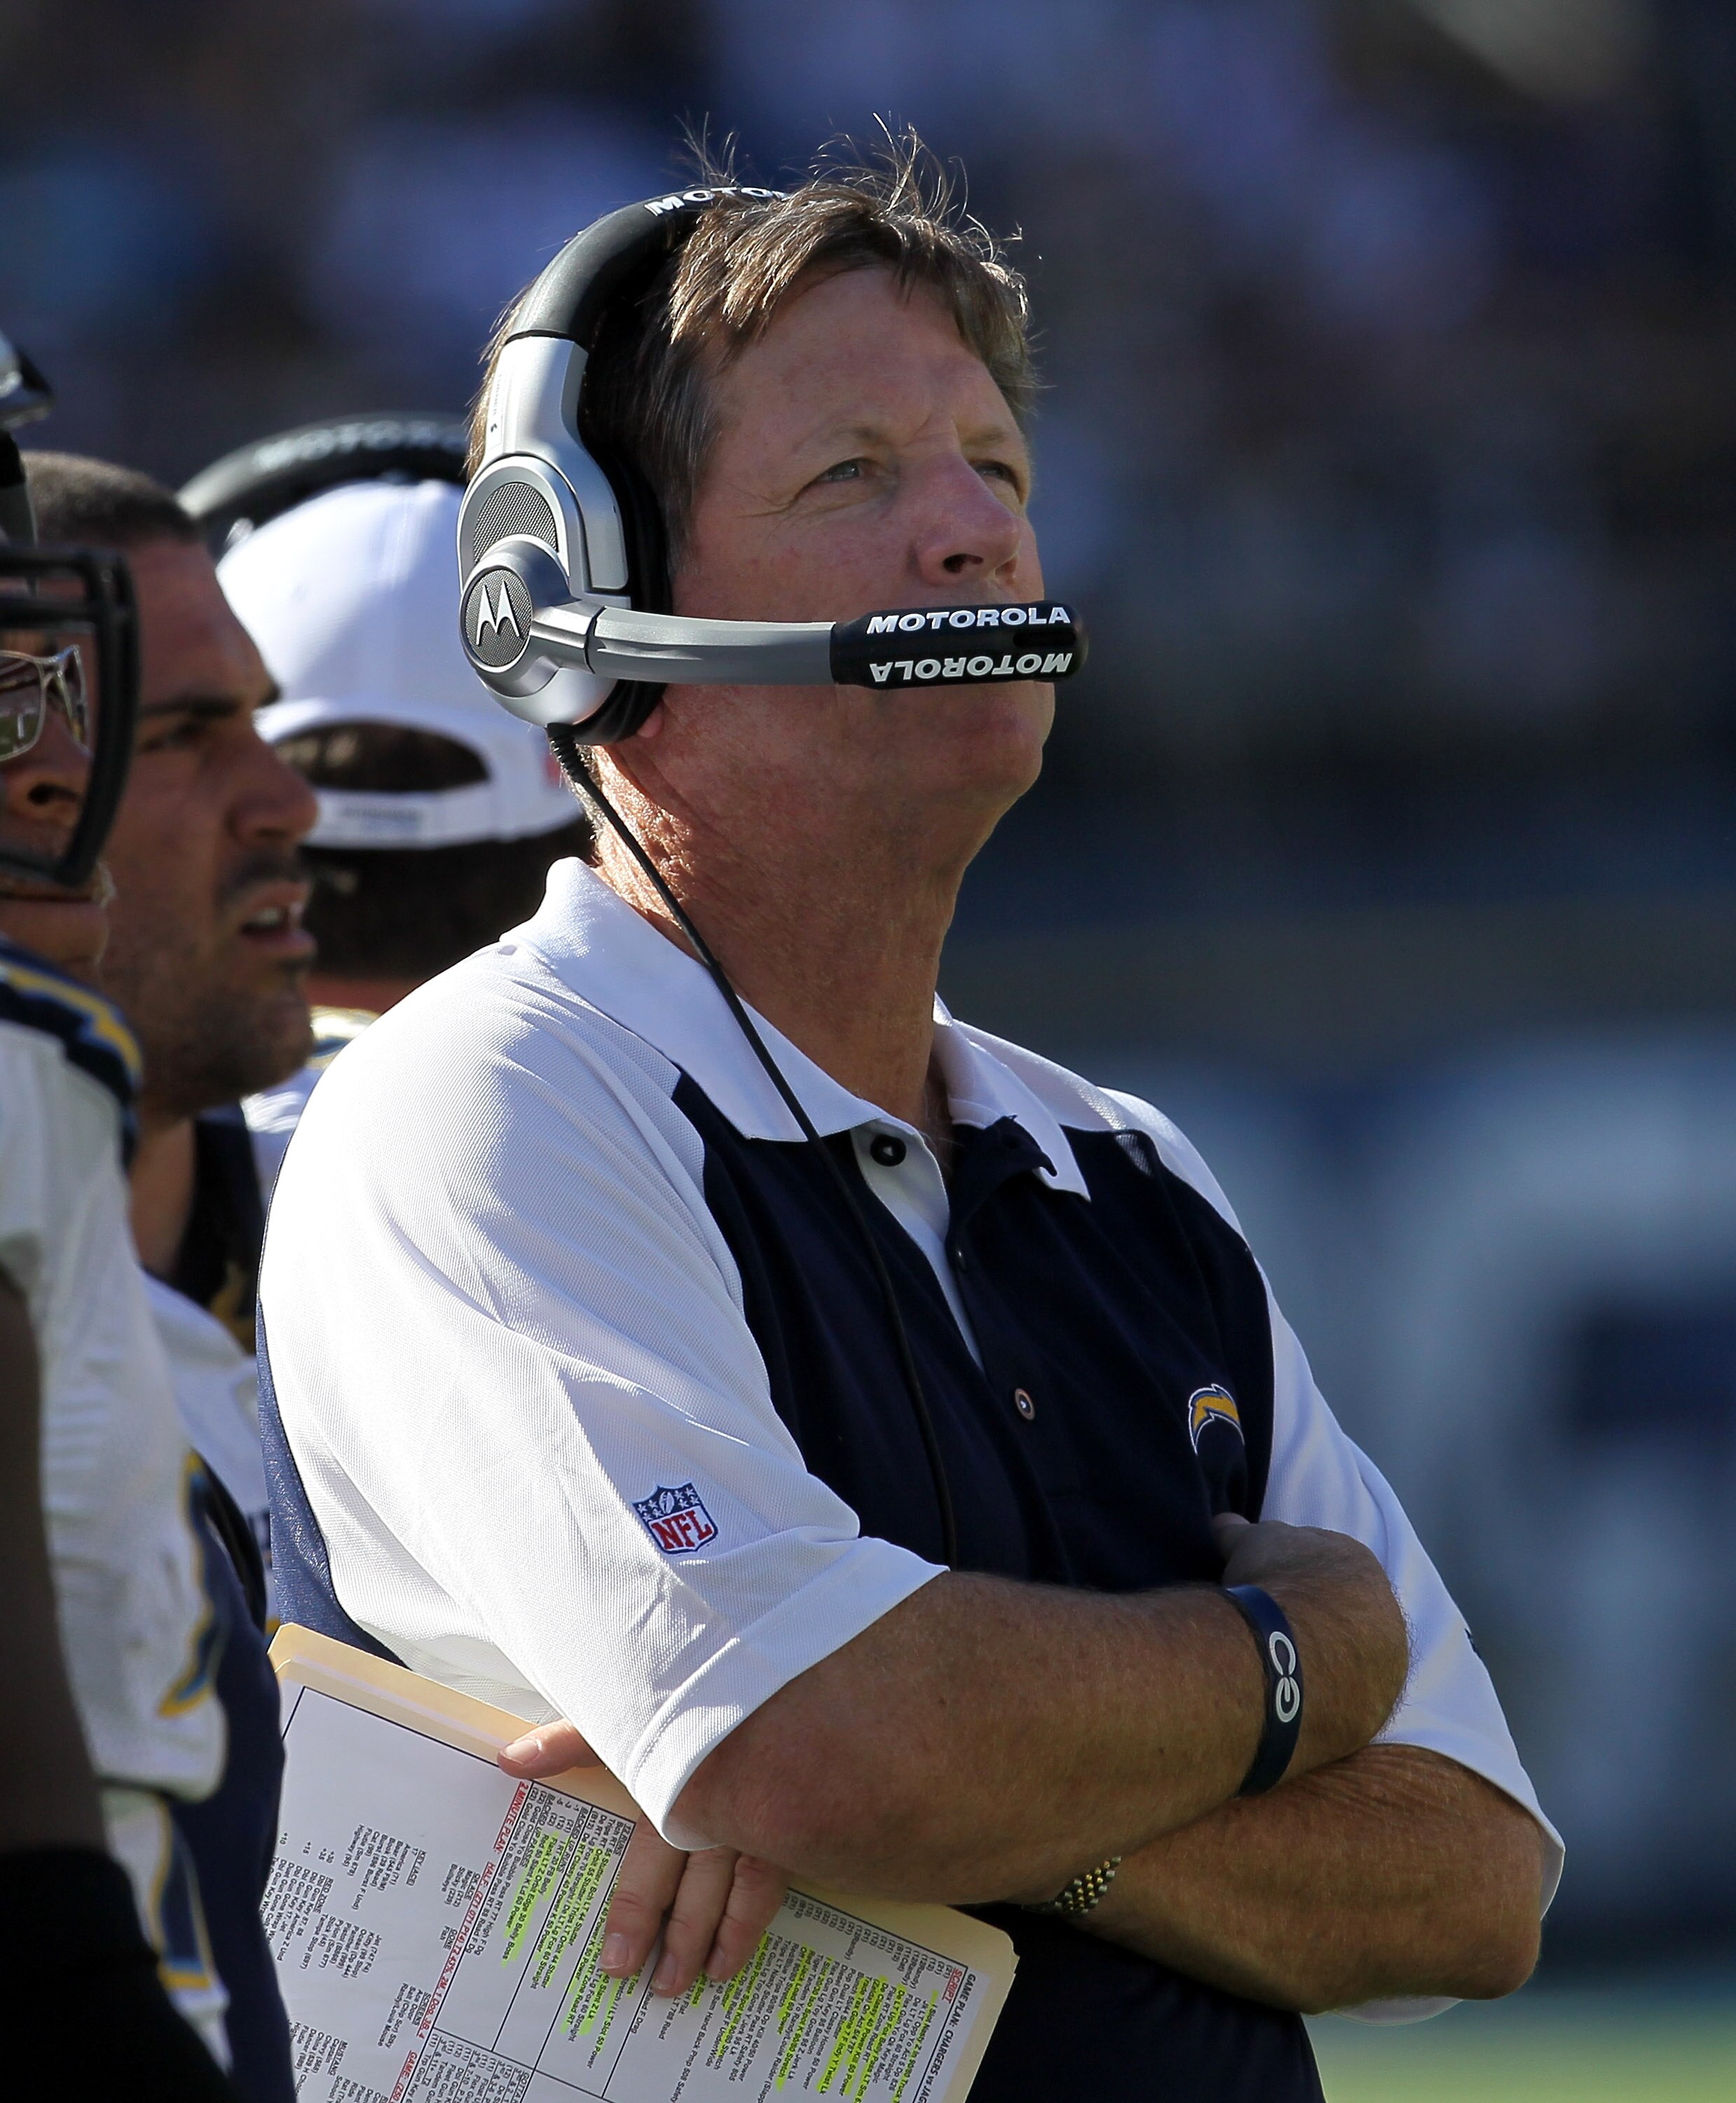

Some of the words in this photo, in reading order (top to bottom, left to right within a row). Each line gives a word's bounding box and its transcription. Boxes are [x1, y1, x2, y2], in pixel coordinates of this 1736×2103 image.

[866, 606, 1072, 634] MOTOROLA
[869, 652, 1073, 683] MOTOROLA
[650, 1509, 714, 1550] NFL
[505, 1789, 526, 1825] MINUTE
[529, 1805, 541, 1823] Gold
[536, 1793, 556, 1826] BACKED
[531, 1825, 542, 1838] UP
[569, 1807, 589, 1839] BACKED
[613, 1820, 623, 1836] Bch
[494, 1826, 511, 1854] PLAN:
[521, 1823, 533, 1844] Close
[538, 1833, 549, 1849] Red
[608, 1836, 617, 1846] RT
[517, 1844, 525, 1856] Yo
[519, 1837, 538, 1868] PASSES
[564, 1839, 575, 1852] UP
[604, 1847, 613, 1857] 55
[505, 1855, 521, 1881] Bubble
[526, 1858, 539, 1878] Slant
[540, 1857, 549, 1867] LT
[556, 1851, 570, 1874] RUNS
[594, 1857, 608, 1882] Stutter
[441, 1863, 457, 1893] Bullseye
[478, 1861, 495, 1888] HALF:
[530, 1874, 542, 1893] Orbit
[321, 1877, 333, 1893] RED
[463, 1884, 476, 1900] ACE
[498, 1881, 510, 1900] Pass
[586, 1886, 596, 1901] Bch
[313, 1893, 327, 1914] ZONE
[493, 1900, 503, 1911] RT
[521, 1892, 534, 1913] Edge
[582, 1901, 591, 1912] LT
[489, 1912, 498, 1921] 77
[505, 1905, 519, 1928] Power
[578, 1912, 586, 1921] 44
[439, 1926, 449, 1940] Fish
[456, 1924, 470, 1943] P14)
[481, 1920, 493, 1938] High
[509, 1921, 522, 1941] Belly
[568, 1921, 582, 1946] Stutter
[443, 1928, 458, 1950] GONE
[778, 1939, 791, 1957] Trips
[451, 1944, 461, 1955] T2
[502, 1941, 514, 1960] Boss
[774, 1958, 783, 1968] LT
[810, 1953, 823, 1972] Tiger
[765, 1968, 779, 1989] Nasty
[834, 1964, 848, 1987] Diesel
[845, 1967, 856, 1983] Pop
[849, 1971, 864, 1995] Bunch
[614, 1975, 629, 2001] Stretch
[800, 1973, 815, 2001] Tandem
[828, 1987, 839, 2003] Gun
[838, 1982, 850, 2000] Dual
[859, 1975, 872, 1996] Trade
[880, 1982, 889, 1993] De
[885, 1985, 896, 2002] Flex
[943, 1968, 963, 2003] SCRIPT
[959, 1973, 976, 2001] GAME
[412, 1992, 431, 2026] SCREENS
[709, 1994, 720, 2011] Sam
[756, 1989, 770, 2014] Stutter
[795, 2001, 804, 2013] Yo
[821, 2002, 832, 2017] Key
[834, 2000, 843, 2010] LT
[854, 1996, 863, 2010] Tax
[869, 1992, 884, 2017] Classy
[882, 2001, 890, 2013] RT
[902, 1993, 913, 2009] Flex
[606, 2009, 615, 2020] LT
[700, 2011, 713, 2031] Hand
[748, 2014, 760, 2033] Pass
[823, 2010, 839, 2035] Classy
[845, 2010, 858, 2030] Gone
[873, 2013, 886, 2031] Zone
[896, 2009, 906, 2025] Gun
[948, 2001, 965, 2027] PLAN:
[600, 2020, 611, 2036] Slot
[777, 2012, 800, 2057] Randy/Louie
[832, 2014, 847, 2039] Stutter
[891, 2025, 900, 2036] Yo
[692, 2031, 705, 2050] Back
[744, 2033, 753, 2044] RT
[806, 2027, 822, 2055] Balloon
[815, 2035, 828, 2057] Home
[856, 2027, 870, 2050] Power
[866, 2031, 878, 2051] Read
[324, 2037, 339, 2064] Captain
[327, 2040, 348, 2076] MUSTANG
[587, 2045, 600, 2069] Power
[685, 2049, 697, 2067] Pmp
[734, 2044, 748, 2067] Safety
[833, 2041, 845, 2058] Indy
[852, 2050, 861, 2063] Kill
[861, 2051, 870, 2062] RT
[880, 2047, 891, 2062] Key
[929, 2029, 954, 2075] CHARGERS
[399, 2050, 418, 2079] GAME:
[767, 2057, 781, 2081] Raider
[870, 2061, 885, 2084] Magic
[802, 2067, 816, 2090] Power
[823, 2066, 835, 2085] Twist
[838, 2073, 852, 2096] Power
[925, 2075, 934, 2085] vs
[670, 2081, 685, 2103] Safety
